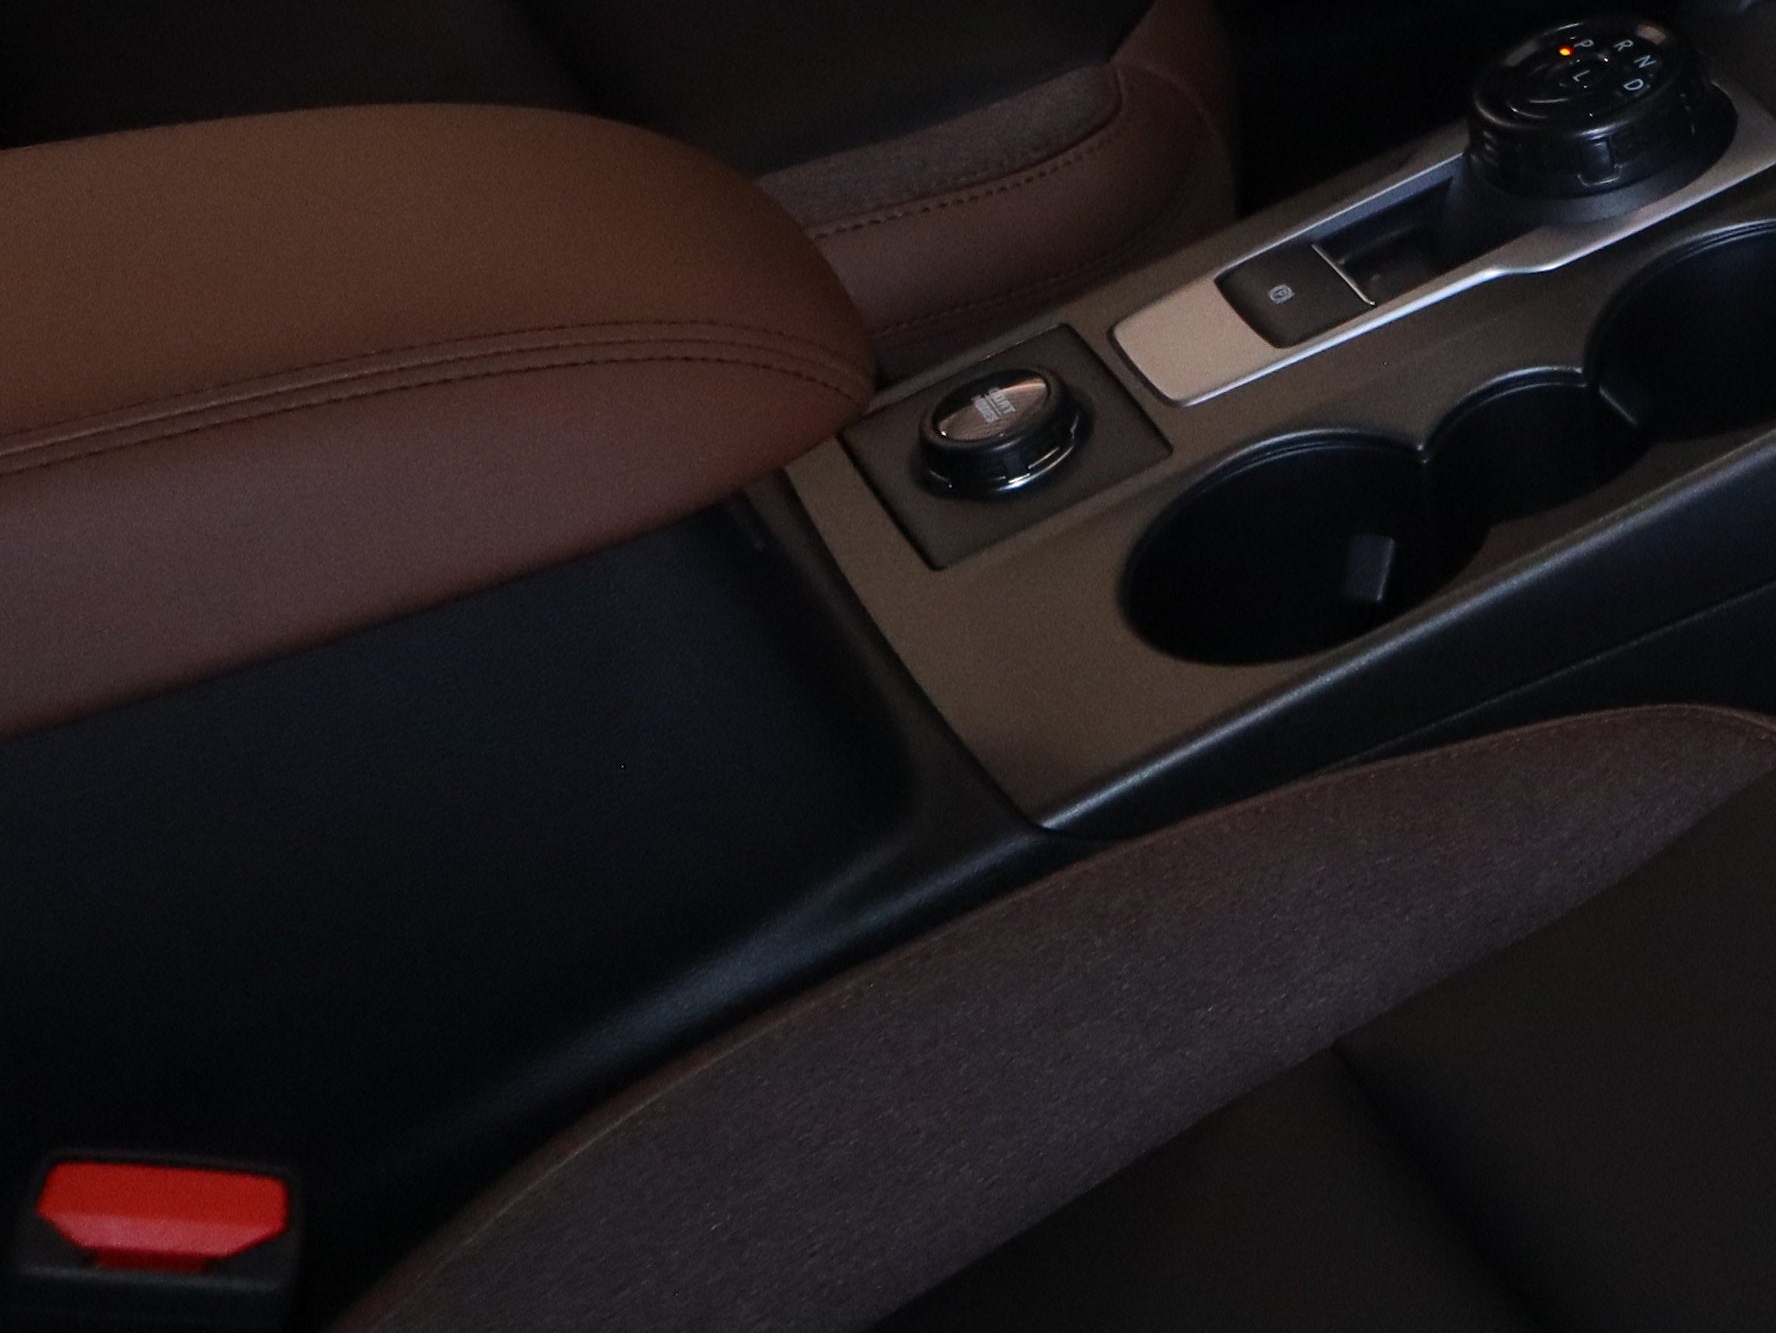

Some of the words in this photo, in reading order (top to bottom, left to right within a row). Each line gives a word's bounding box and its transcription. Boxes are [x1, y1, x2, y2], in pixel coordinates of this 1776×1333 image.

[1573, 38, 1595, 49] P
[1612, 39, 1635, 52] R
[1633, 54, 1657, 69] N
[1572, 69, 1591, 83] L
[1623, 78, 1645, 92] D
